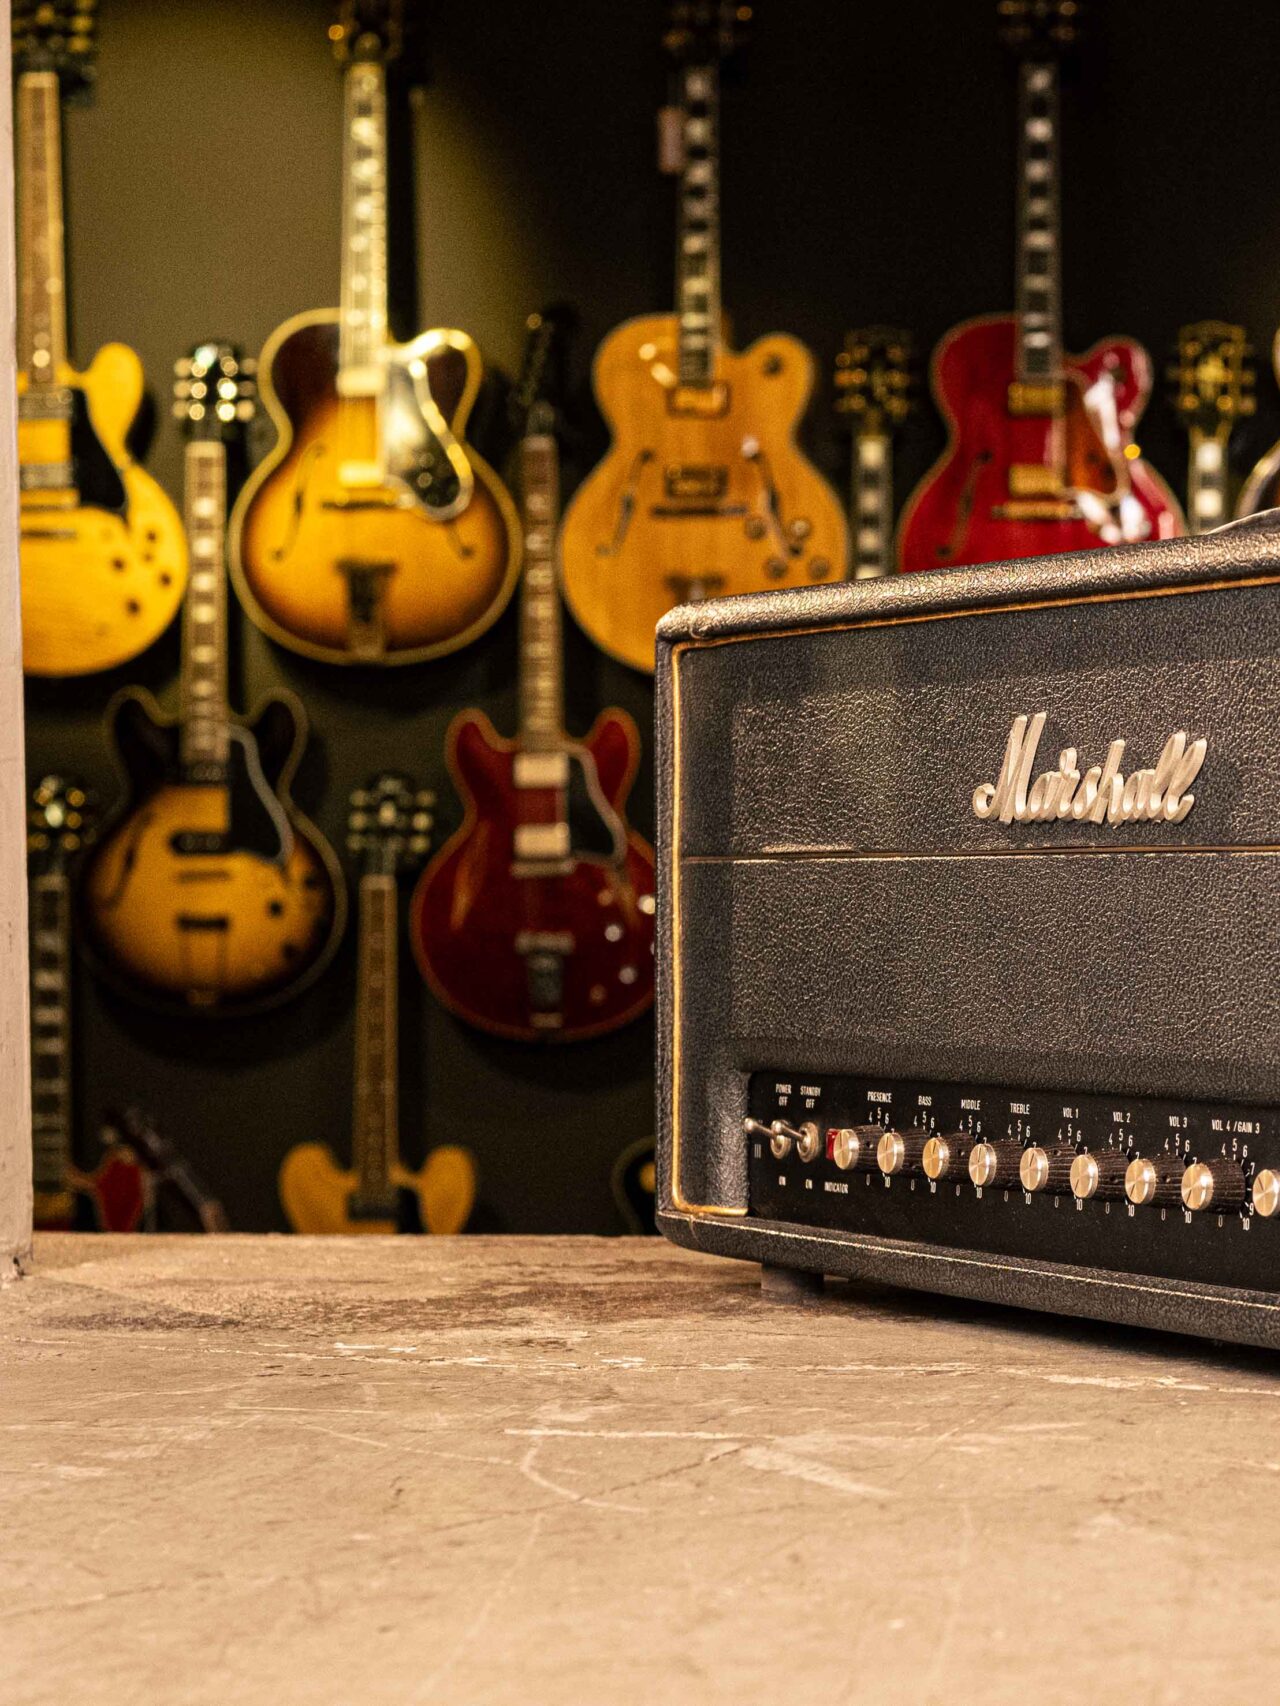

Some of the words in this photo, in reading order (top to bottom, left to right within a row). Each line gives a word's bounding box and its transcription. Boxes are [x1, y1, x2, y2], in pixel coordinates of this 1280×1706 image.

[972, 712, 1207, 827] Marshall
[776, 1084, 791, 1095] POWER
[800, 1086, 821, 1096] STANDBY
[779, 1096, 788, 1106] OFF
[867, 1091, 892, 1103] PRESENCE
[918, 1095, 932, 1106] BASS
[806, 1099, 815, 1108] OFF
[961, 1099, 980, 1110] MIDDLE
[1010, 1102, 1030, 1115] TREBLE
[868, 1111, 873, 1123] 4
[878, 1107, 881, 1119] 5
[885, 1113, 889, 1124] 6
[922, 1111, 926, 1123] 5
[1063, 1107, 1073, 1118] VOL
[1113, 1111, 1124, 1122] VOL
[1126, 1112, 1131, 1123] 2
[913, 1115, 917, 1127] 4
[930, 1117, 935, 1129] 6
[959, 1120, 963, 1131] 4
[968, 1115, 972, 1128] 5
[976, 1121, 981, 1133] 6
[1017, 1120, 1021, 1132] 5
[1169, 1116, 1180, 1127] VOL
[1183, 1117, 1187, 1128] 3
[1212, 1119, 1223, 1131] VOL
[1226, 1120, 1230, 1131] 4
[1255, 1122, 1260, 1134] 3
[1007, 1124, 1012, 1136] 4
[1026, 1125, 1030, 1137] 6
[1058, 1128, 1062, 1140] 4
[1068, 1124, 1072, 1136] 5
[1076, 1130, 1081, 1142] 6
[1119, 1128, 1123, 1141] 5
[1109, 1132, 1113, 1145] 4
[1128, 1134, 1133, 1147] 6
[1164, 1138, 1168, 1150] 4
[1175, 1133, 1180, 1146] 5
[1185, 1140, 1190, 1152] 6
[1221, 1143, 1226, 1156] 4
[1232, 1138, 1237, 1152] 5
[1243, 1145, 1248, 1158] 6
[1250, 1162, 1255, 1175] 7
[805, 1179, 812, 1189] ON
[866, 1174, 870, 1186] 0
[885, 1177, 890, 1188] 10
[911, 1179, 915, 1191] 0
[824, 1182, 848, 1194] INDICATOR
[930, 1182, 936, 1194] 10
[956, 1184, 960, 1196] 0
[976, 1187, 982, 1198] 10
[1004, 1190, 1008, 1202] 0
[1025, 1192, 1031, 1205] 10
[1055, 1196, 1059, 1208] 0
[1076, 1199, 1082, 1211] 10
[1105, 1202, 1110, 1214] 0
[1128, 1204, 1134, 1217] 10
[1249, 1202, 1254, 1215] 9
[1161, 1208, 1166, 1221] 0
[1185, 1211, 1192, 1223] 10
[1218, 1215, 1223, 1228] 0
[1242, 1217, 1250, 1231] 10
